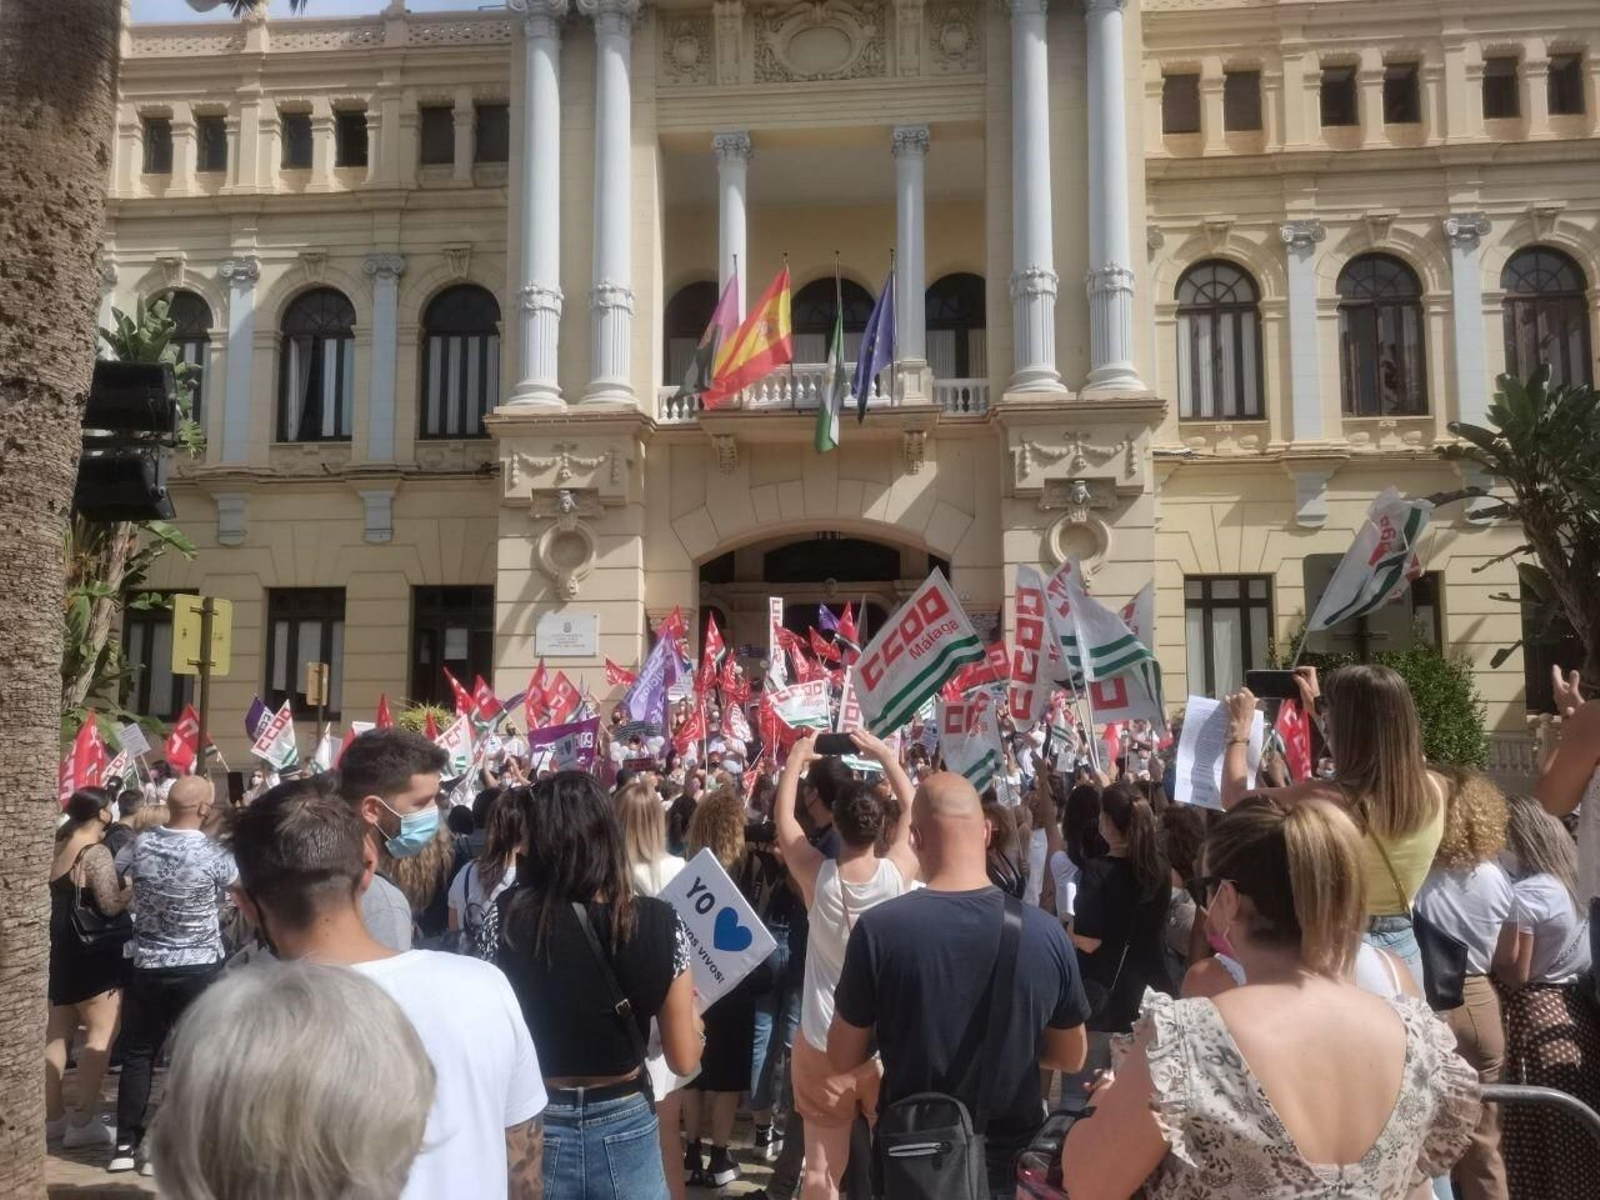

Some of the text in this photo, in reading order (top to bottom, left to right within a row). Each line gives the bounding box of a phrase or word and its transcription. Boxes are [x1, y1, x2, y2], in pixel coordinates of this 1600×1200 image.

[860, 585, 950, 692] CCOO
[908, 618, 960, 661] Málaga
[1009, 587, 1045, 720] CCOO
[256, 707, 291, 752] CCOO
[686, 876, 716, 915] YO
[698, 946, 725, 984] VIVOS!
